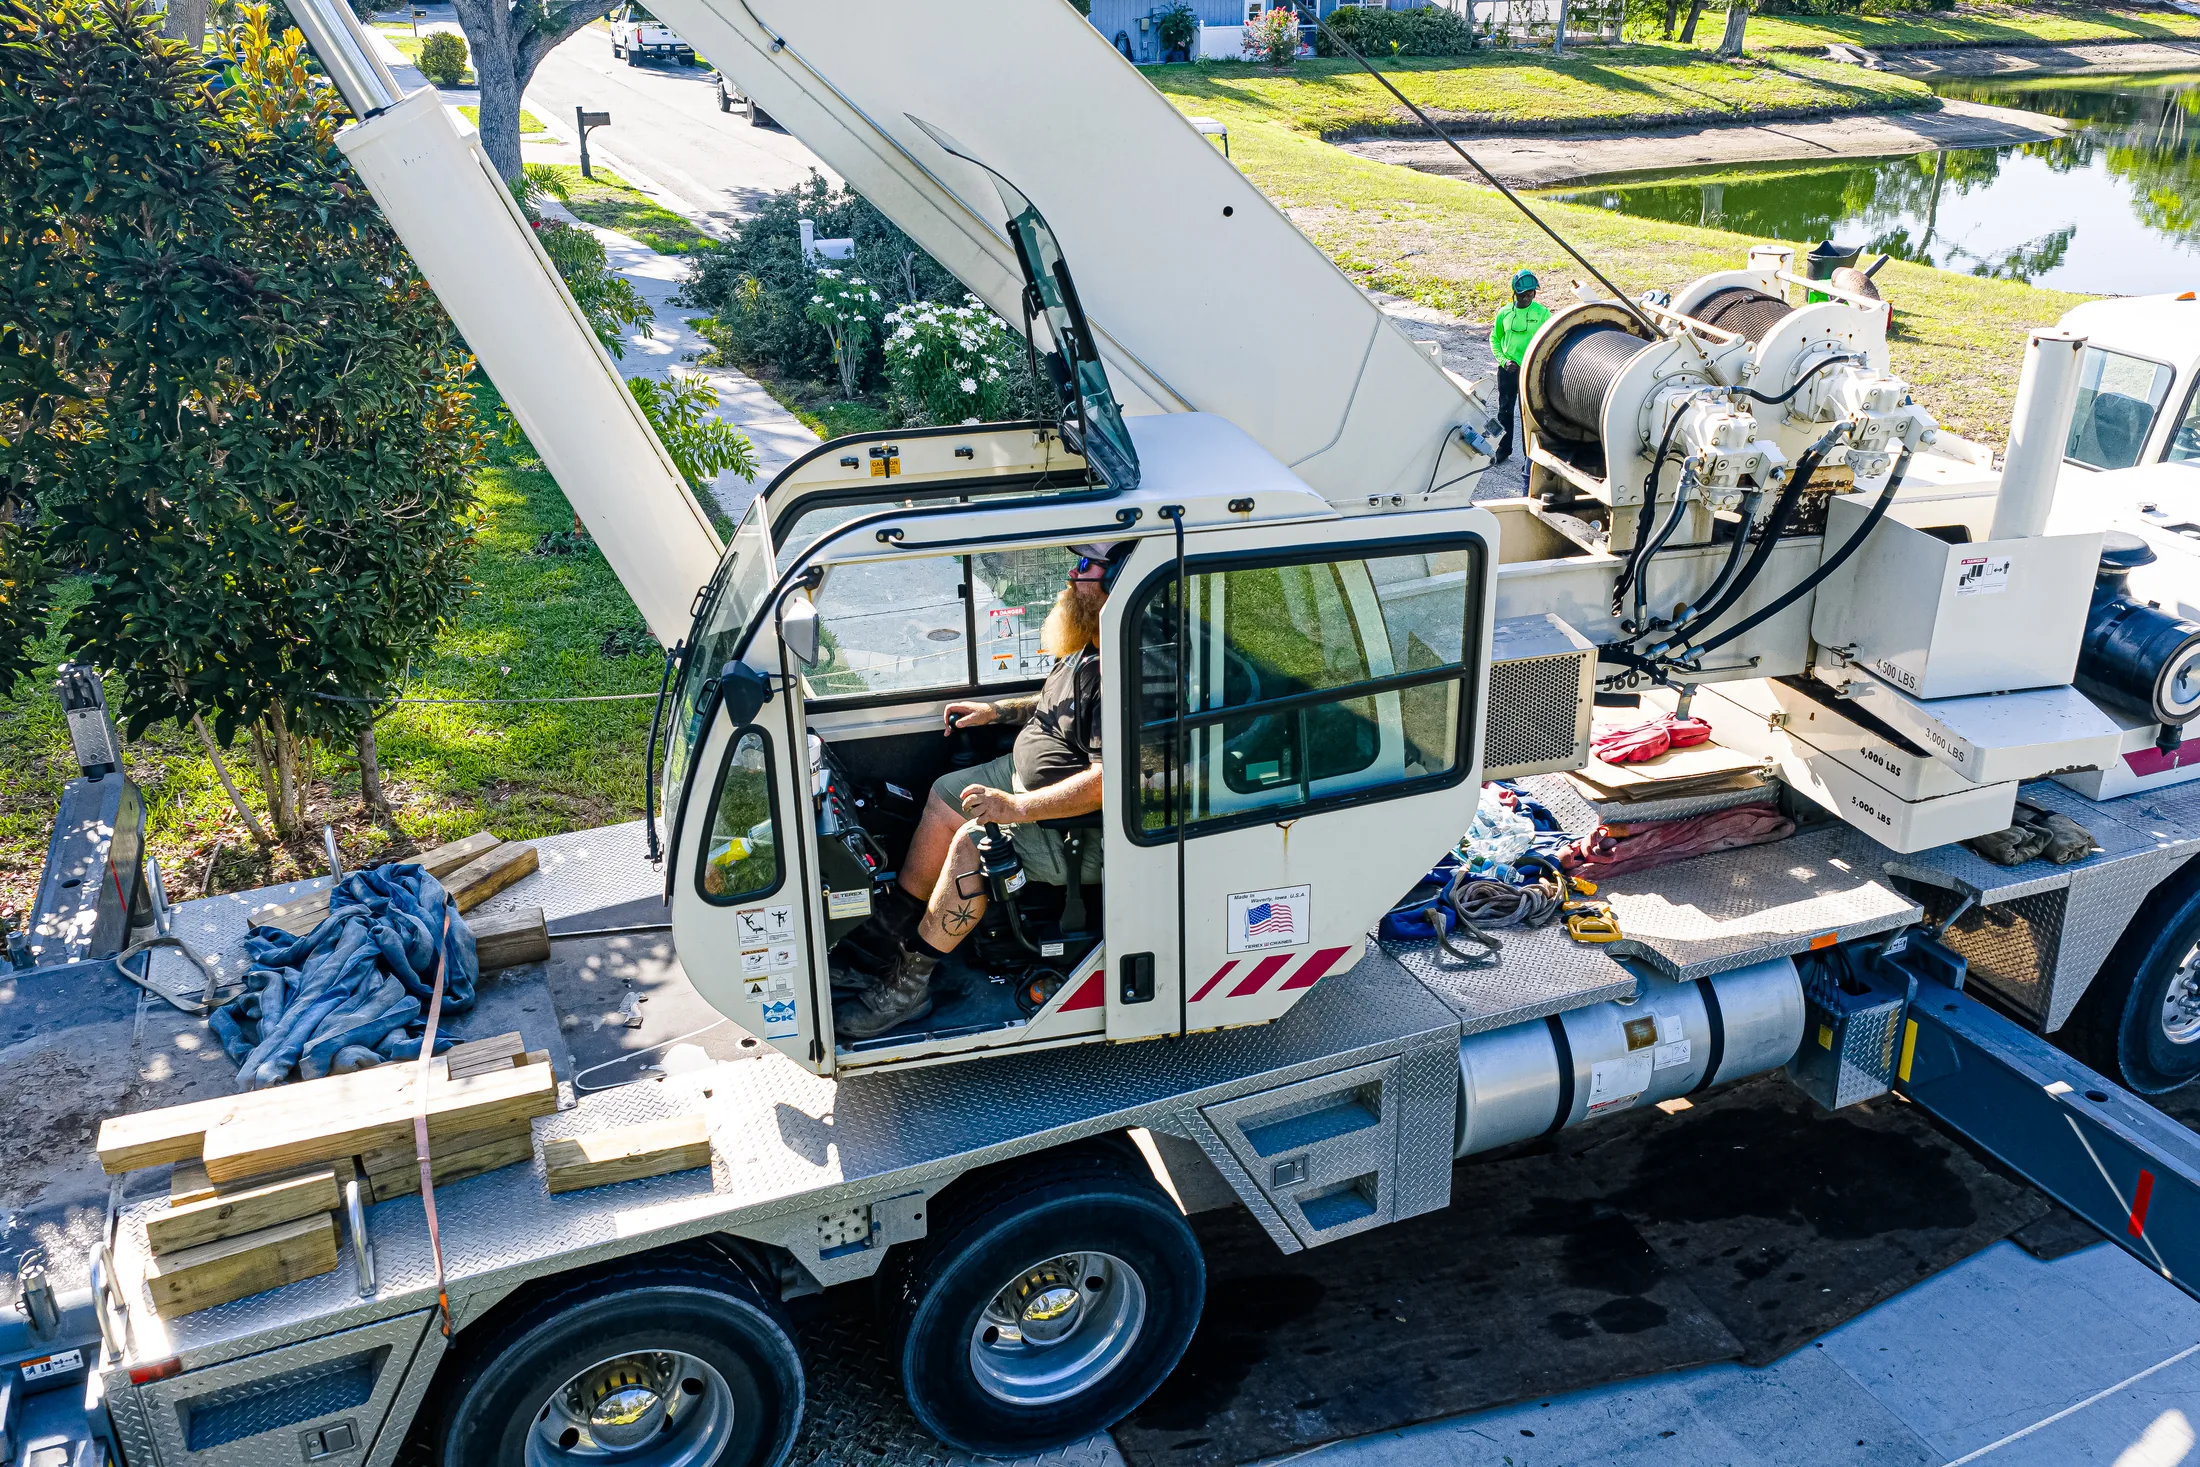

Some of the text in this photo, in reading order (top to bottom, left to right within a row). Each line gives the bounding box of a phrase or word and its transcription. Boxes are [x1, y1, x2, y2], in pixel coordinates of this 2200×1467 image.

[1876, 658, 1917, 691] 4,500 LBS.
[1925, 727, 1965, 762] 3,000 LBS
[1860, 746, 1902, 777] 4,000 LBS
[1851, 796, 1891, 826] 5,000 LBS
[766, 1015, 795, 1023] OK
